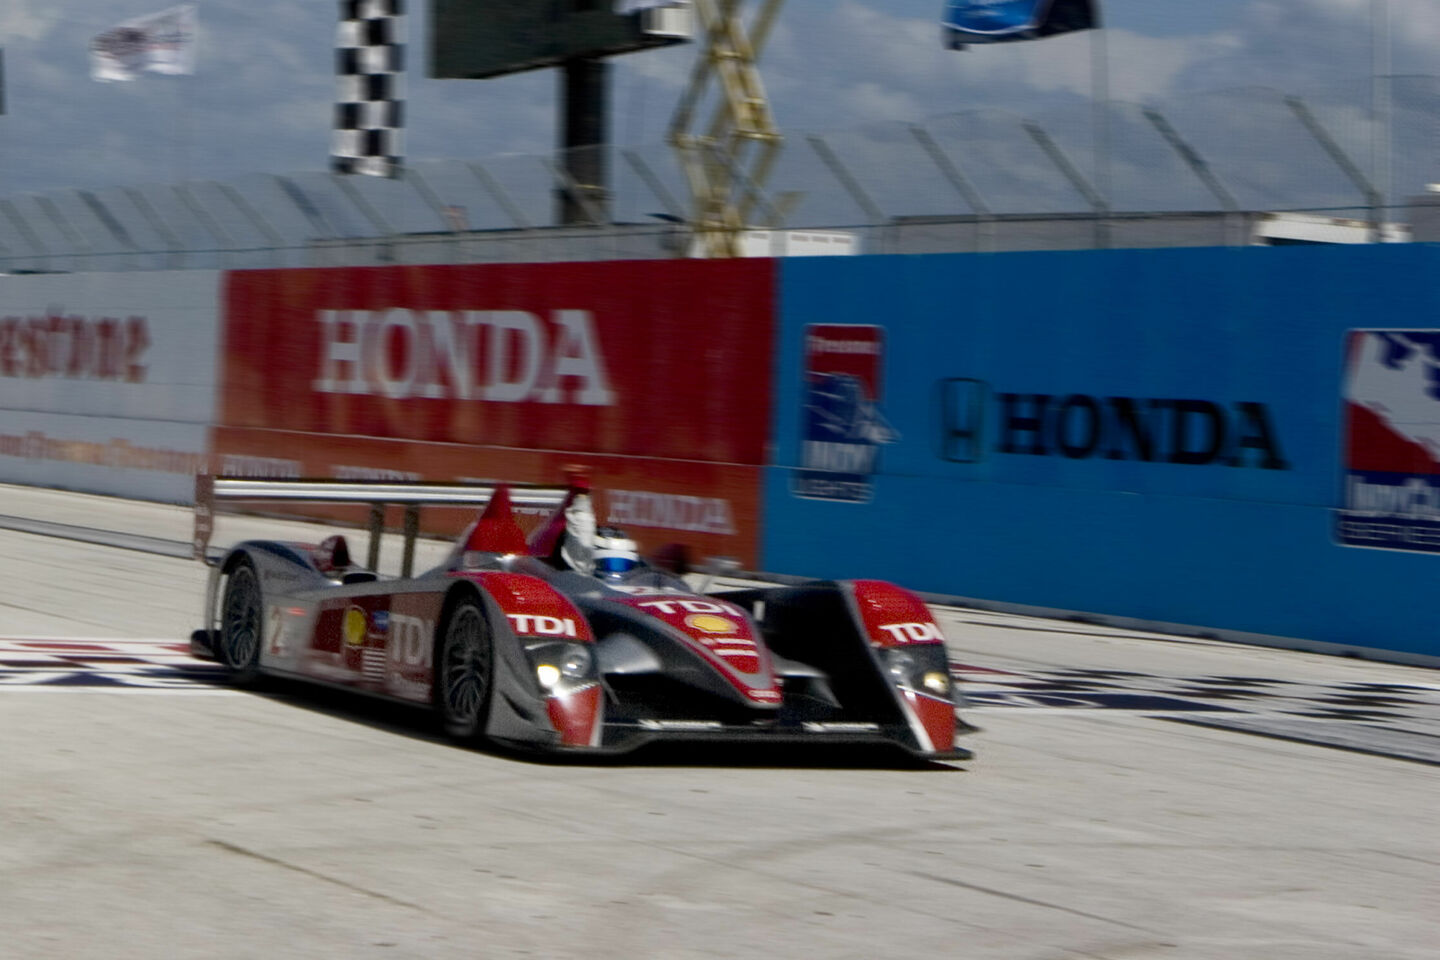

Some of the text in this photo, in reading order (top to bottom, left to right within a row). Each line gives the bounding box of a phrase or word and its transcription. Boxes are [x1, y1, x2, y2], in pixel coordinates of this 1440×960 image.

[312, 307, 618, 407] HONDA
[994, 392, 1291, 471] HONDA
[606, 488, 735, 535] HONDA
[505, 613, 577, 638] TDI
[638, 599, 742, 618] TDI
[877, 621, 945, 643] TDI
[388, 613, 436, 671] TDI
